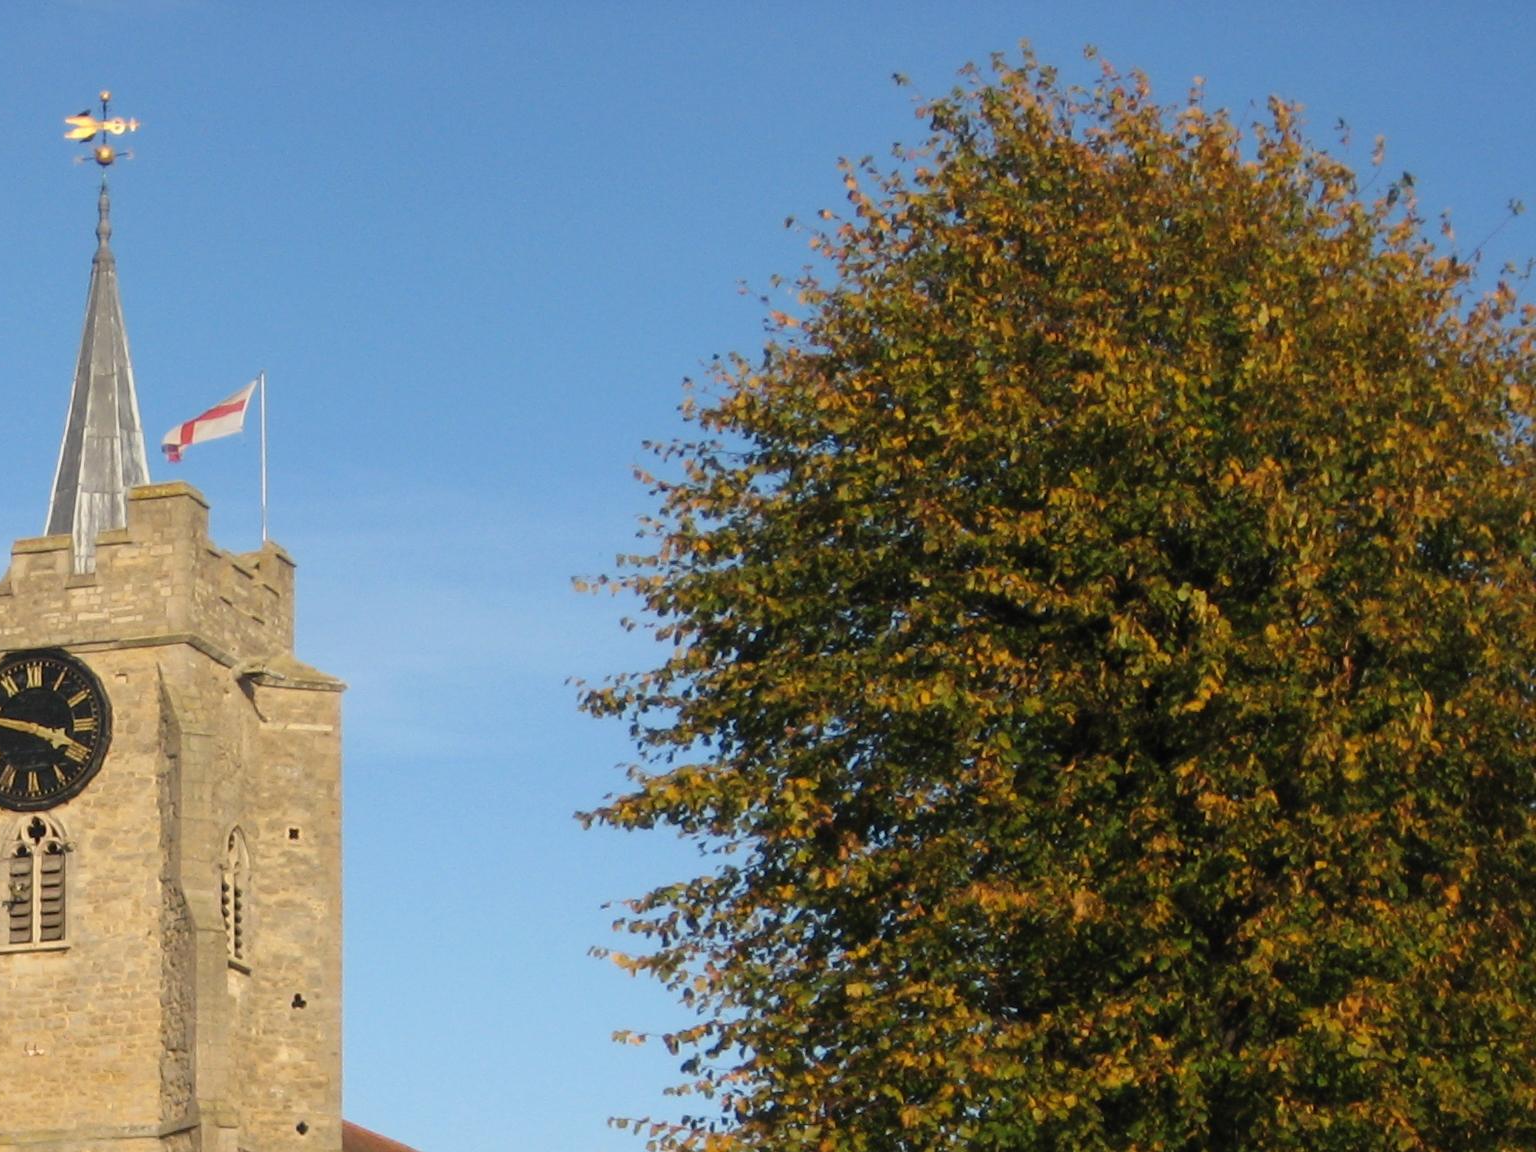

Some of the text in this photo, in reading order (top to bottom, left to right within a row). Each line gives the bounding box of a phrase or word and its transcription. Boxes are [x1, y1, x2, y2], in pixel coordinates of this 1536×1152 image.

[0, 675, 20, 698] XI
[26, 665, 43, 688] XII
[53, 671, 66, 691] I
[67, 689, 90, 708] II
[73, 718, 97, 732] III
[27, 770, 40, 792] VI
